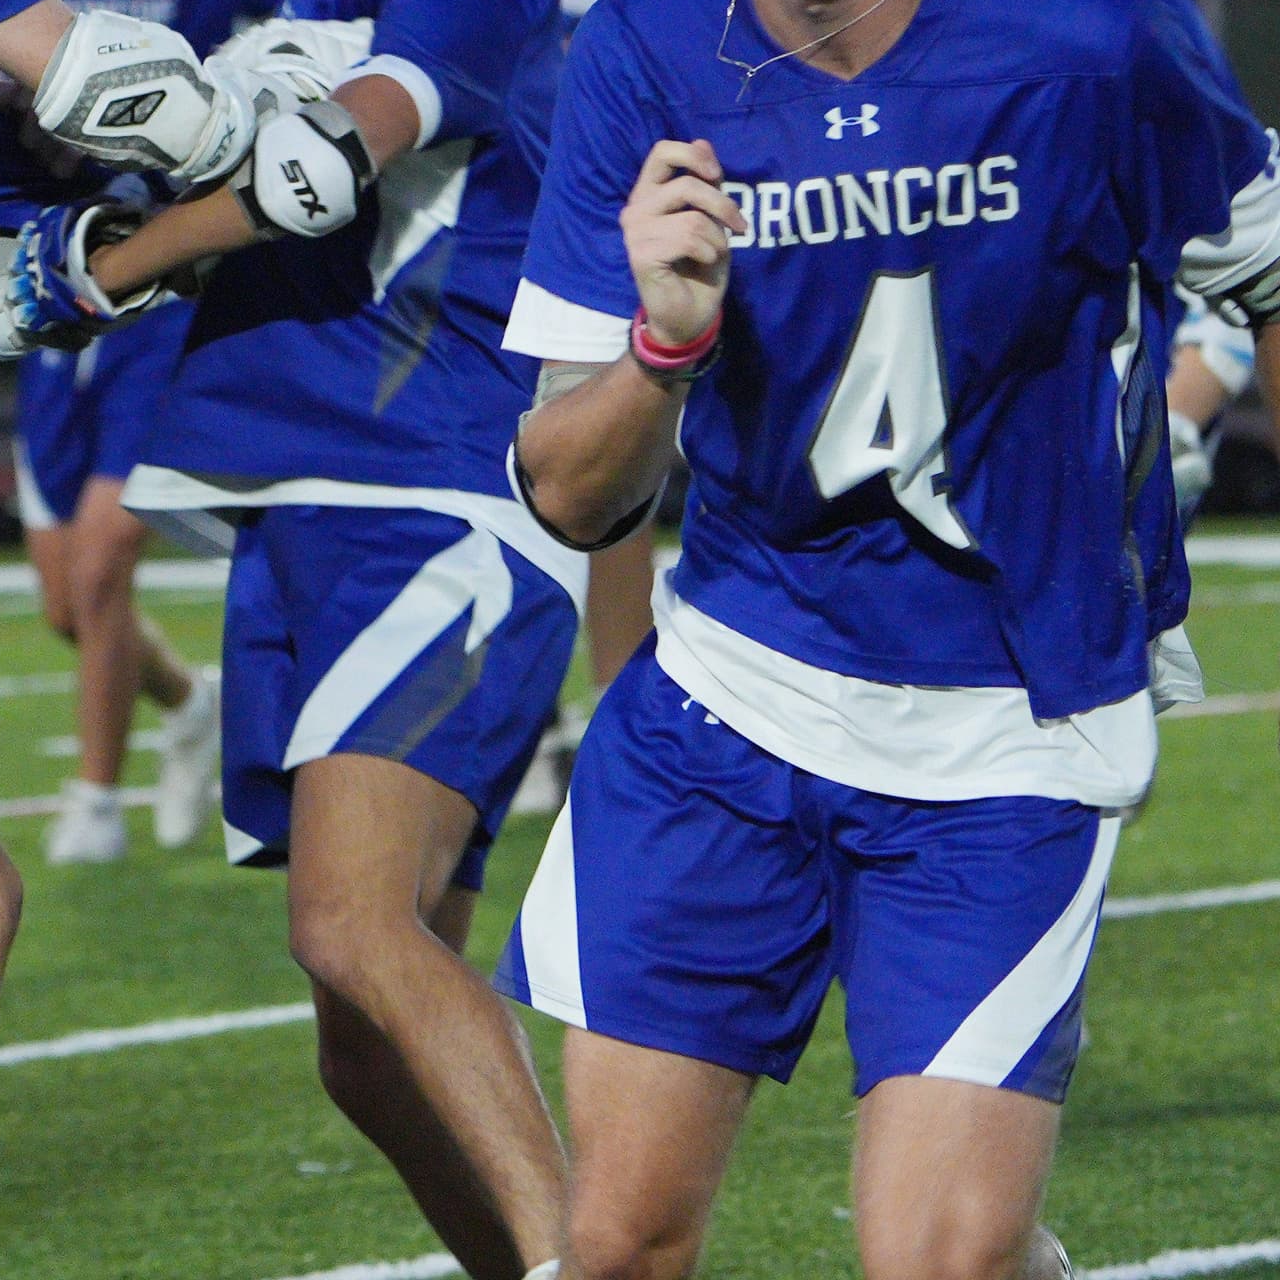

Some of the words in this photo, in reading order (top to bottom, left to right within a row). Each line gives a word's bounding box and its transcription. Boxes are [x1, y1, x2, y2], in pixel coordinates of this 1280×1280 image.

[278, 158, 330, 220] STX
[720, 154, 1020, 250] BRONCOS
[809, 266, 980, 551] 4
